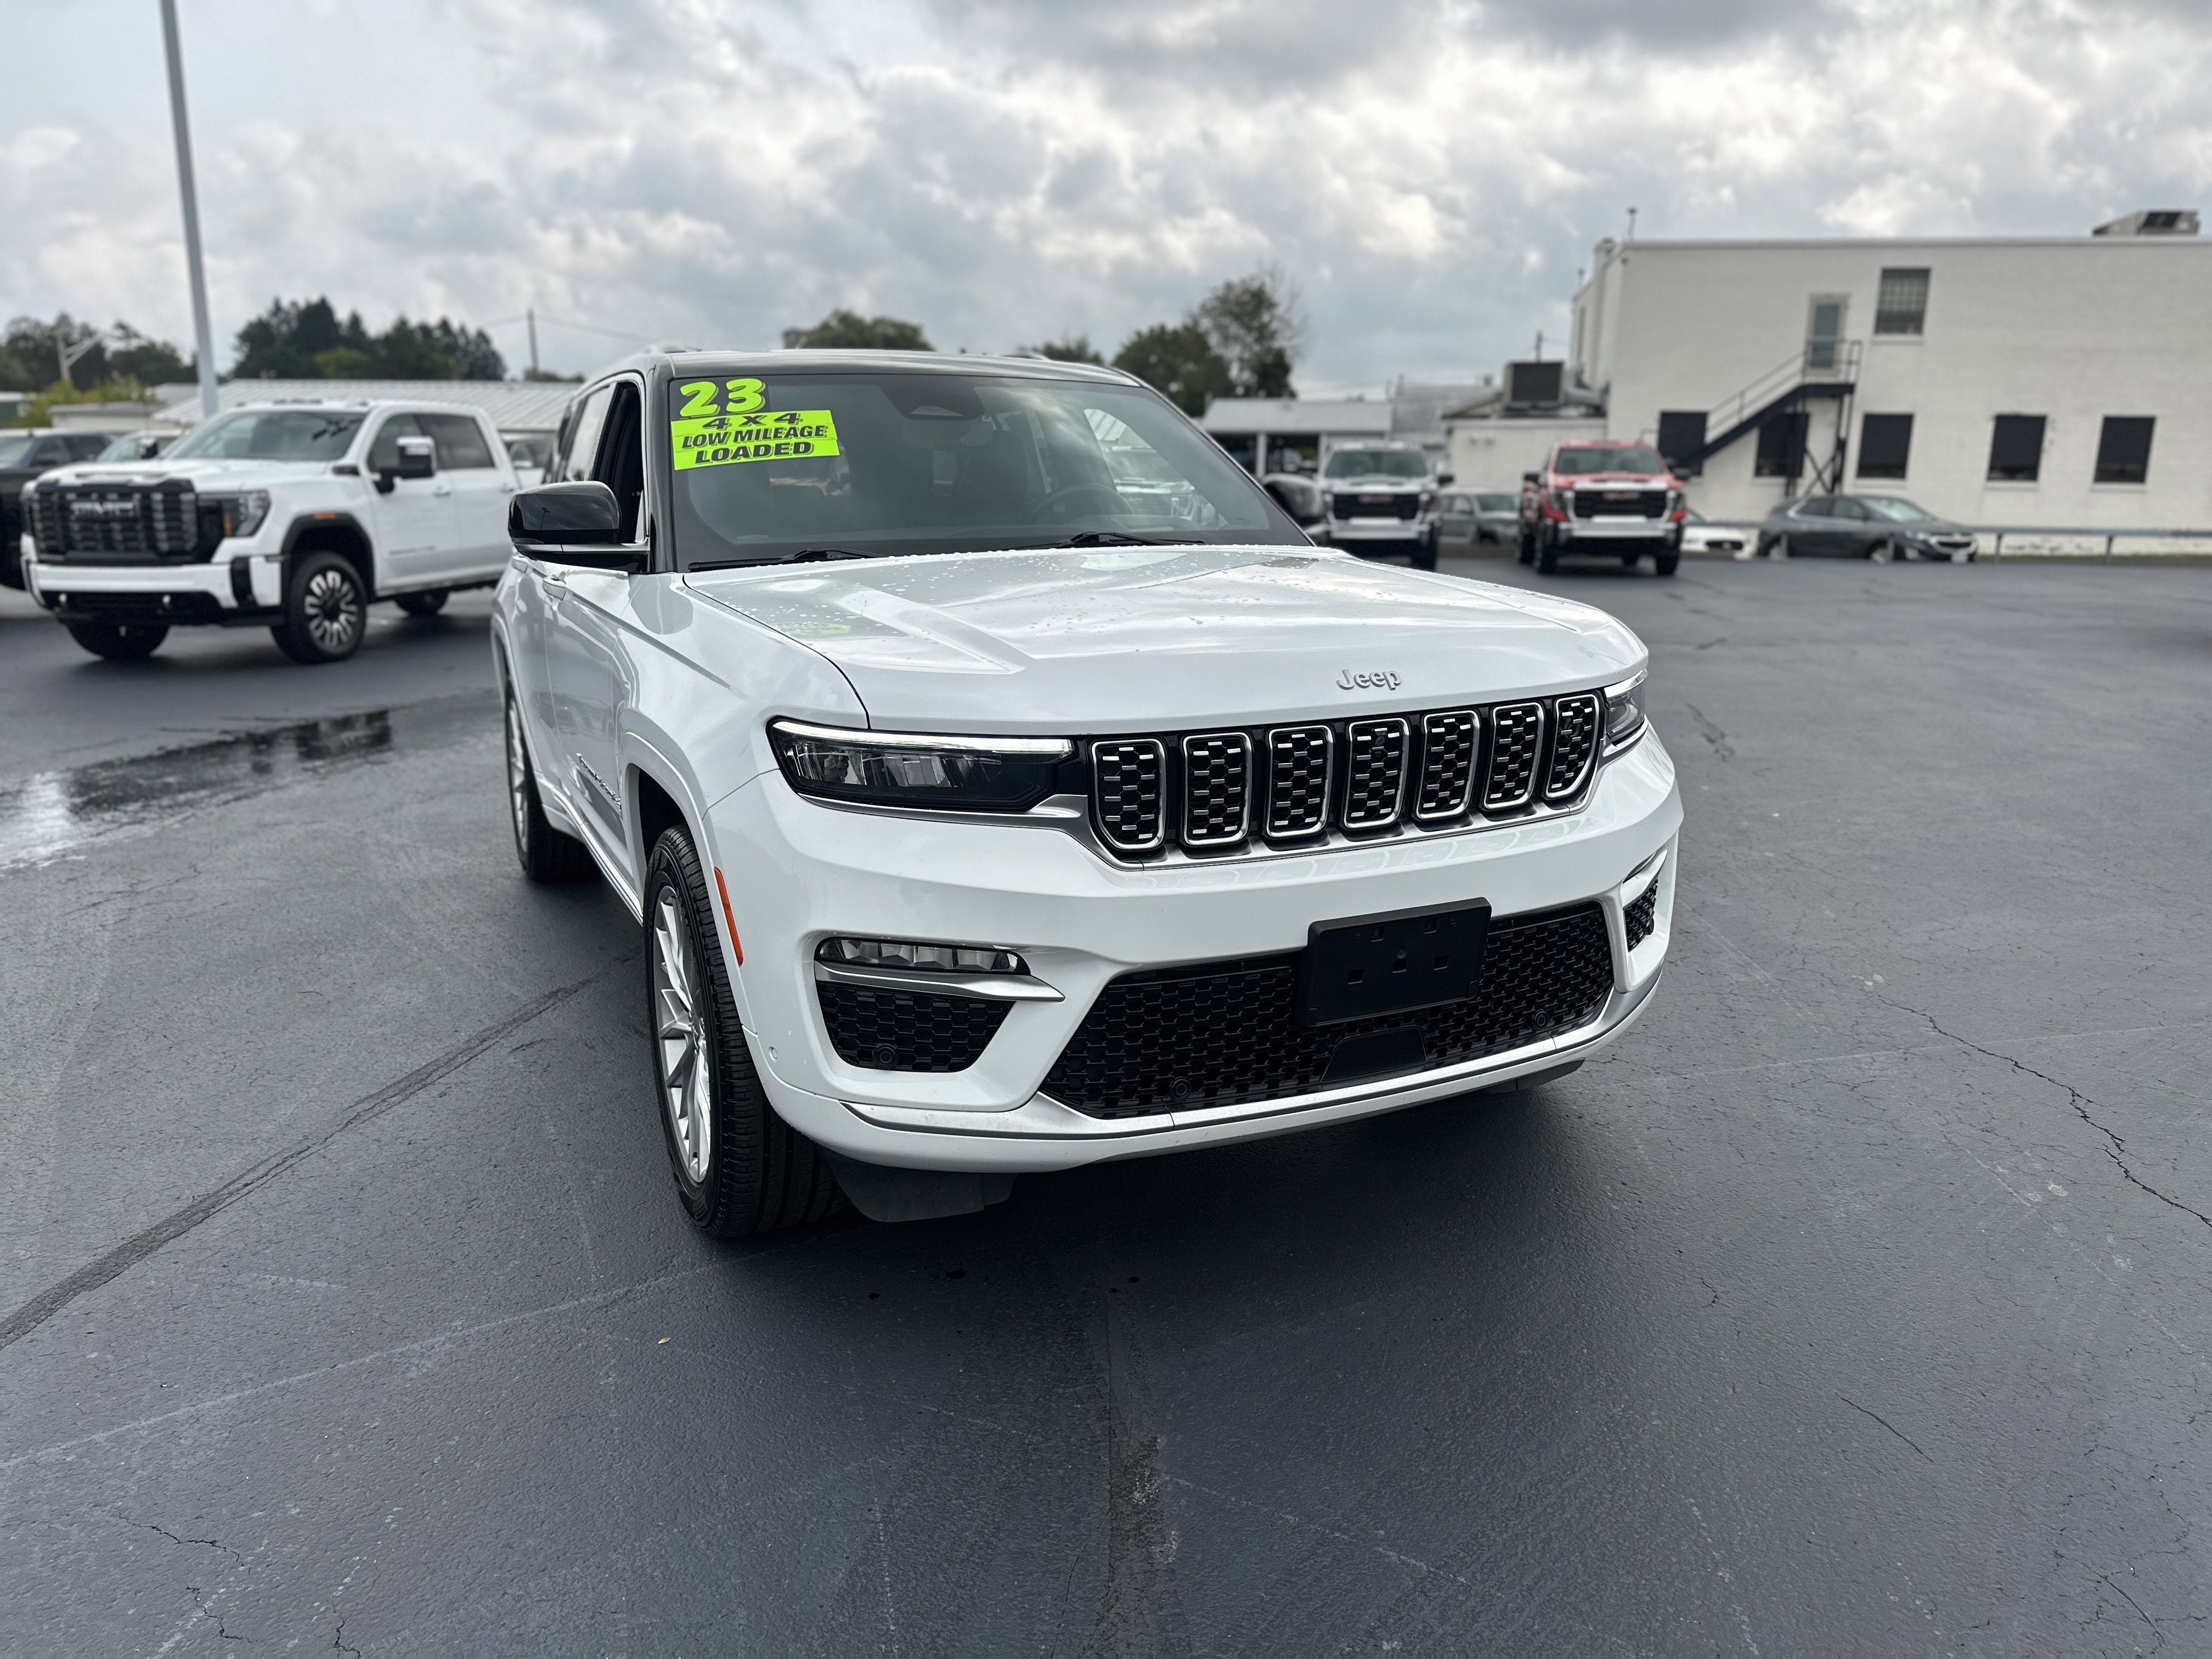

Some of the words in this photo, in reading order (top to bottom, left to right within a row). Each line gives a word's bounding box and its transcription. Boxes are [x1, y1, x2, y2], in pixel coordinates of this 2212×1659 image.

[680, 379, 765, 417] 23
[682, 431, 731, 449] LOW
[733, 425, 828, 443] MILEAGE
[695, 441, 815, 465] LOADED
[1336, 669, 1402, 691] Jeep
